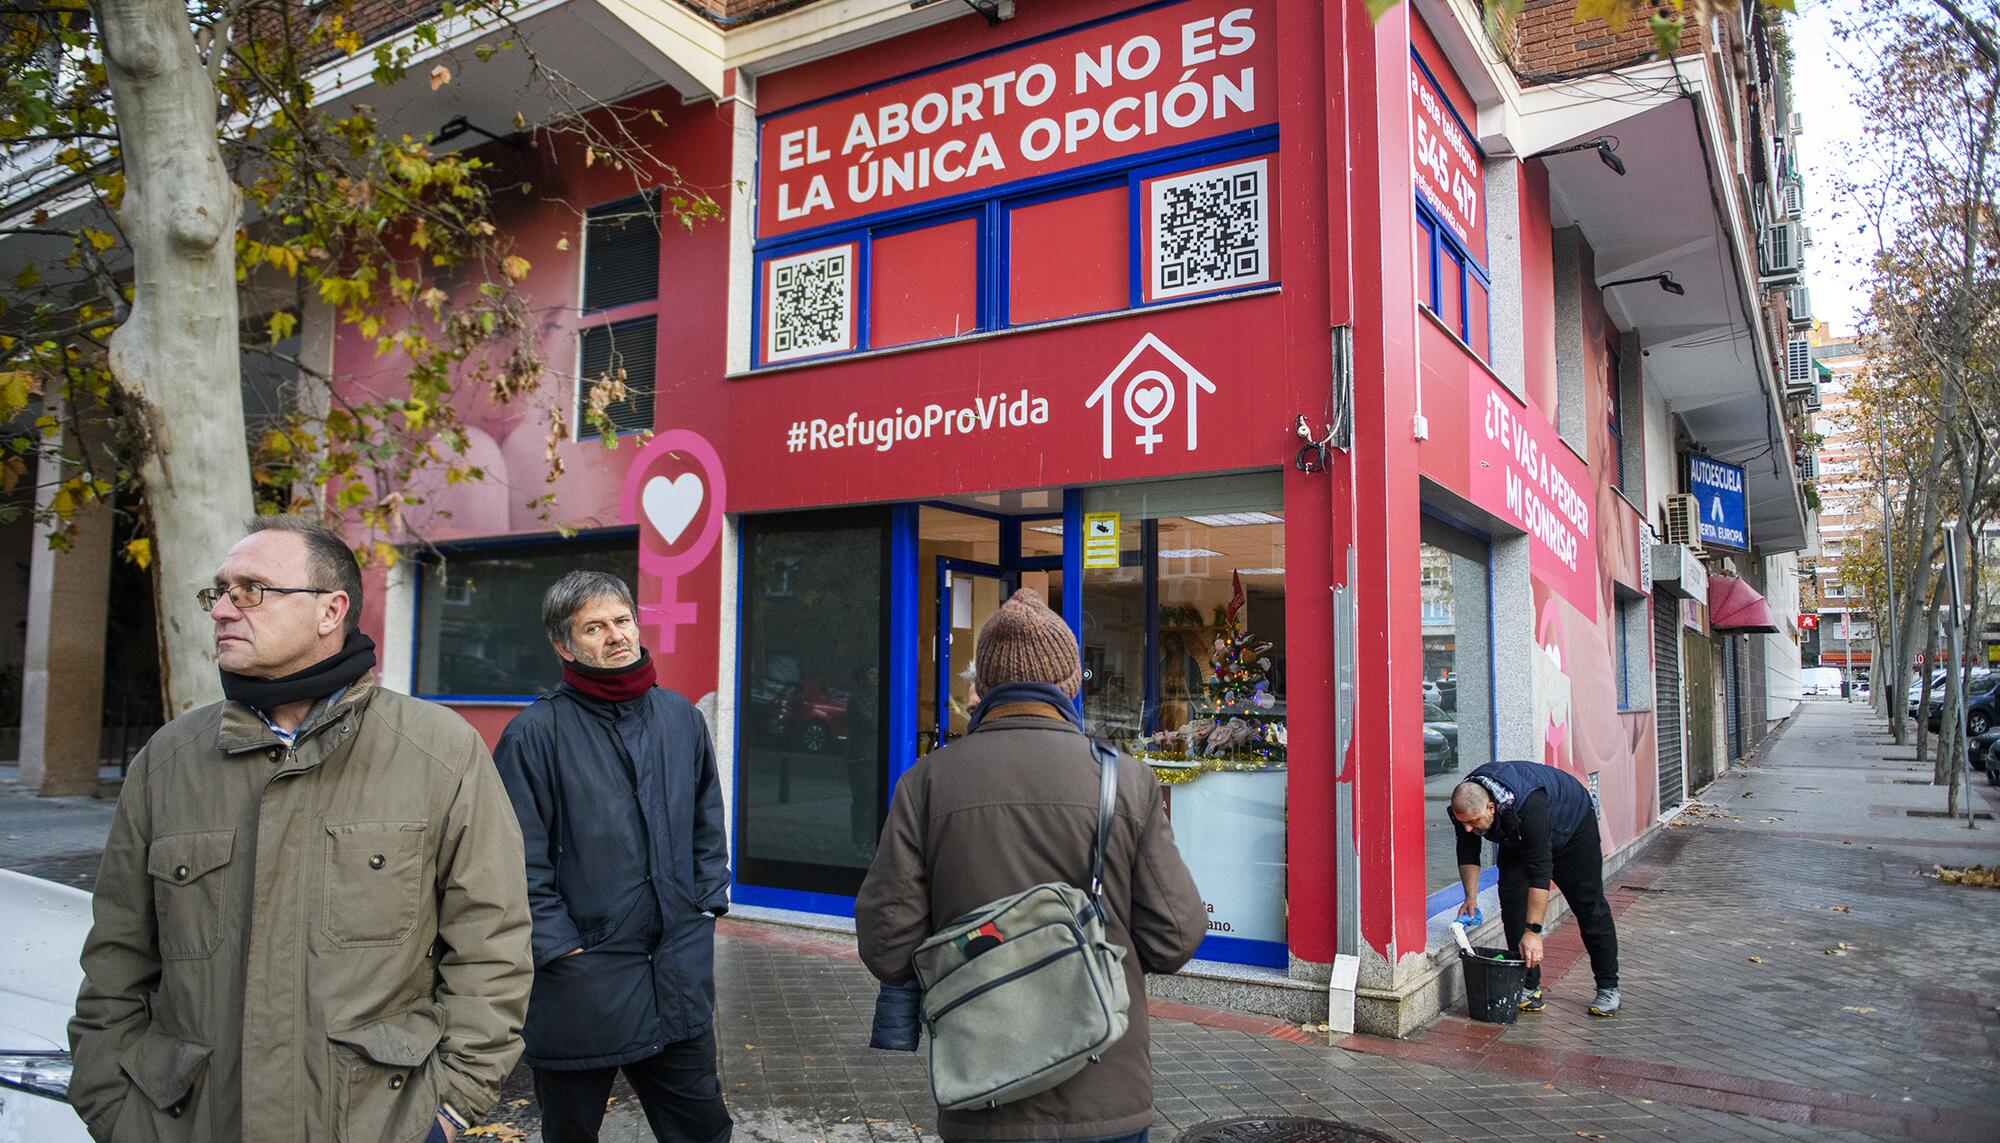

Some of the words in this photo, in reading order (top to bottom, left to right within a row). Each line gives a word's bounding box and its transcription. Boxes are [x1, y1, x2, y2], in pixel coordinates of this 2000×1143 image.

[779, 126, 831, 172] EL
[841, 63, 1057, 156] ABORTO
[1075, 35, 1161, 95] NO
[1181, 8, 1256, 68] ES
[1411, 71, 1419, 96] a
[1420, 84, 1441, 127] este
[1442, 111, 1477, 178] teléfono
[778, 174, 835, 222] LA
[848, 131, 1006, 203] ÚNICA
[1019, 66, 1256, 162] OPCIÓN
[1417, 114, 1450, 193] 545
[1452, 167, 1477, 229] 417
[787, 389, 1050, 454] #RefugioProVida
[1484, 389, 1511, 451] ¿TE
[1511, 414, 1538, 481] VAS
[1539, 452, 1550, 496] A
[1550, 462, 1590, 540] PERDER
[1506, 465, 1523, 521] MI
[1524, 486, 1578, 573] SONRISA?
[1690, 458, 1743, 494] AUTOESCUELA
[1700, 523, 1717, 538] ERTA
[1718, 526, 1744, 544] EUROPA
[1207, 920, 1235, 932] ano.
